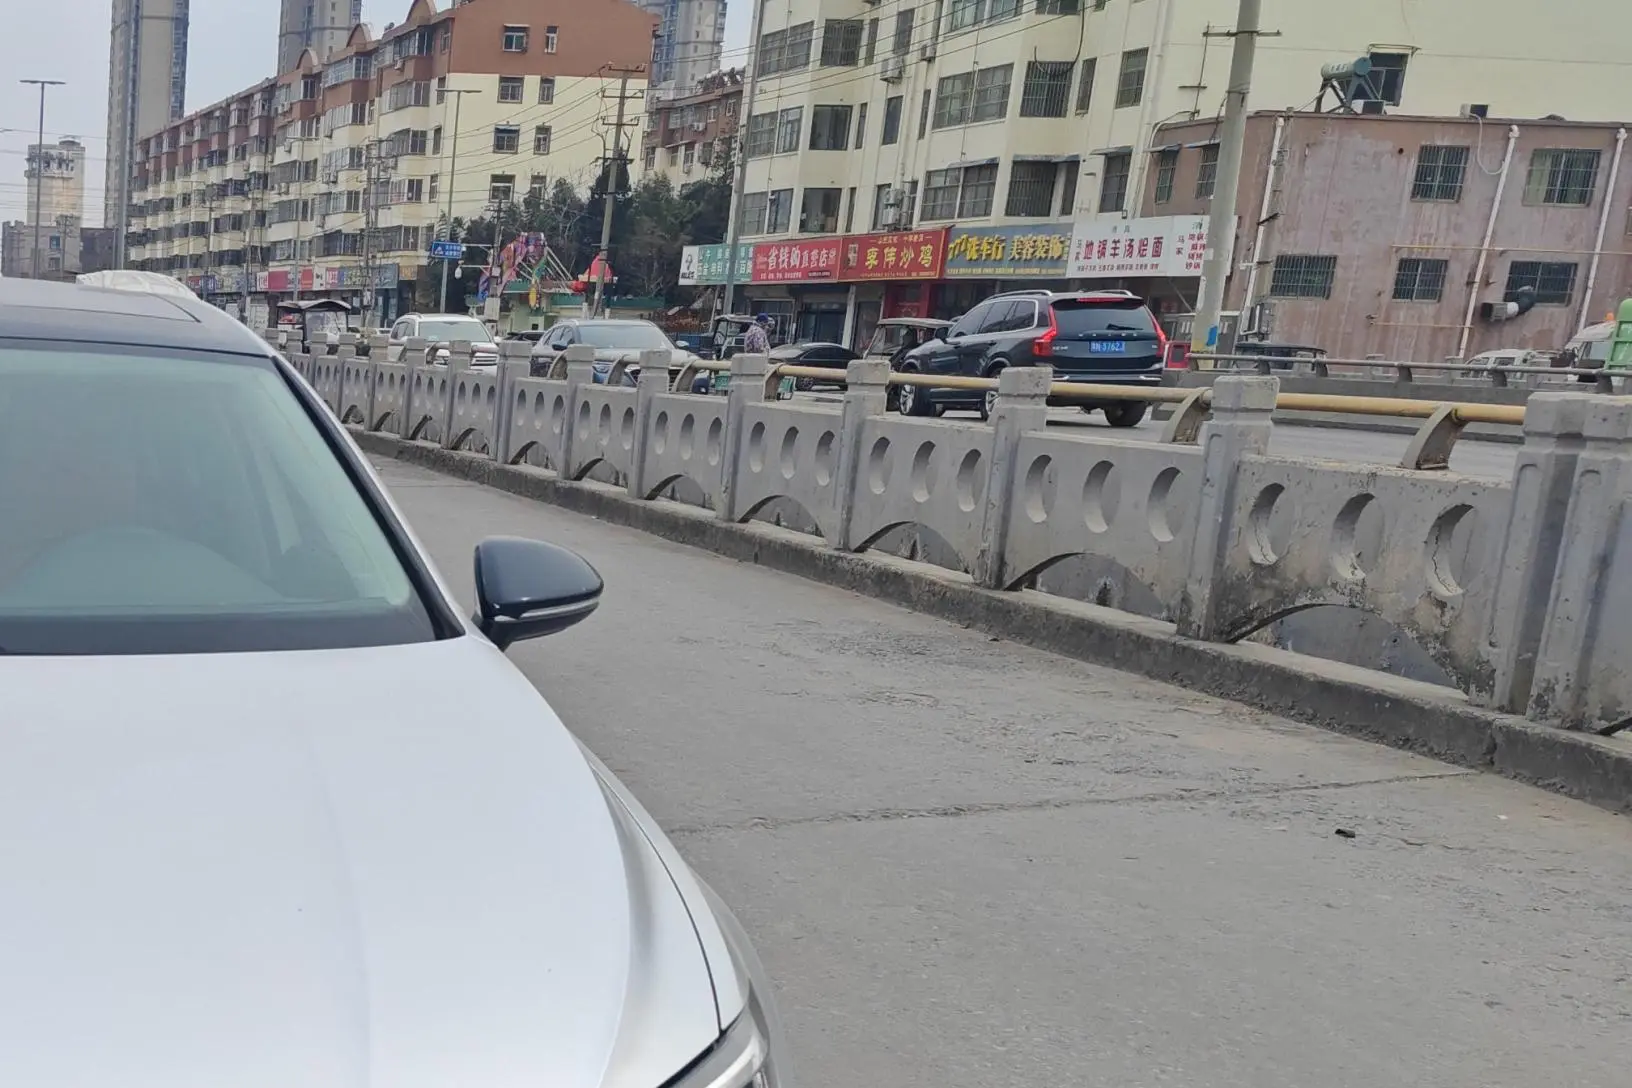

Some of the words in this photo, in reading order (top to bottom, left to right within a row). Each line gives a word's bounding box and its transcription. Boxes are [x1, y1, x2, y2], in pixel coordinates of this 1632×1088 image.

[1083, 236, 1164, 260] 地锅羊汤烩面
